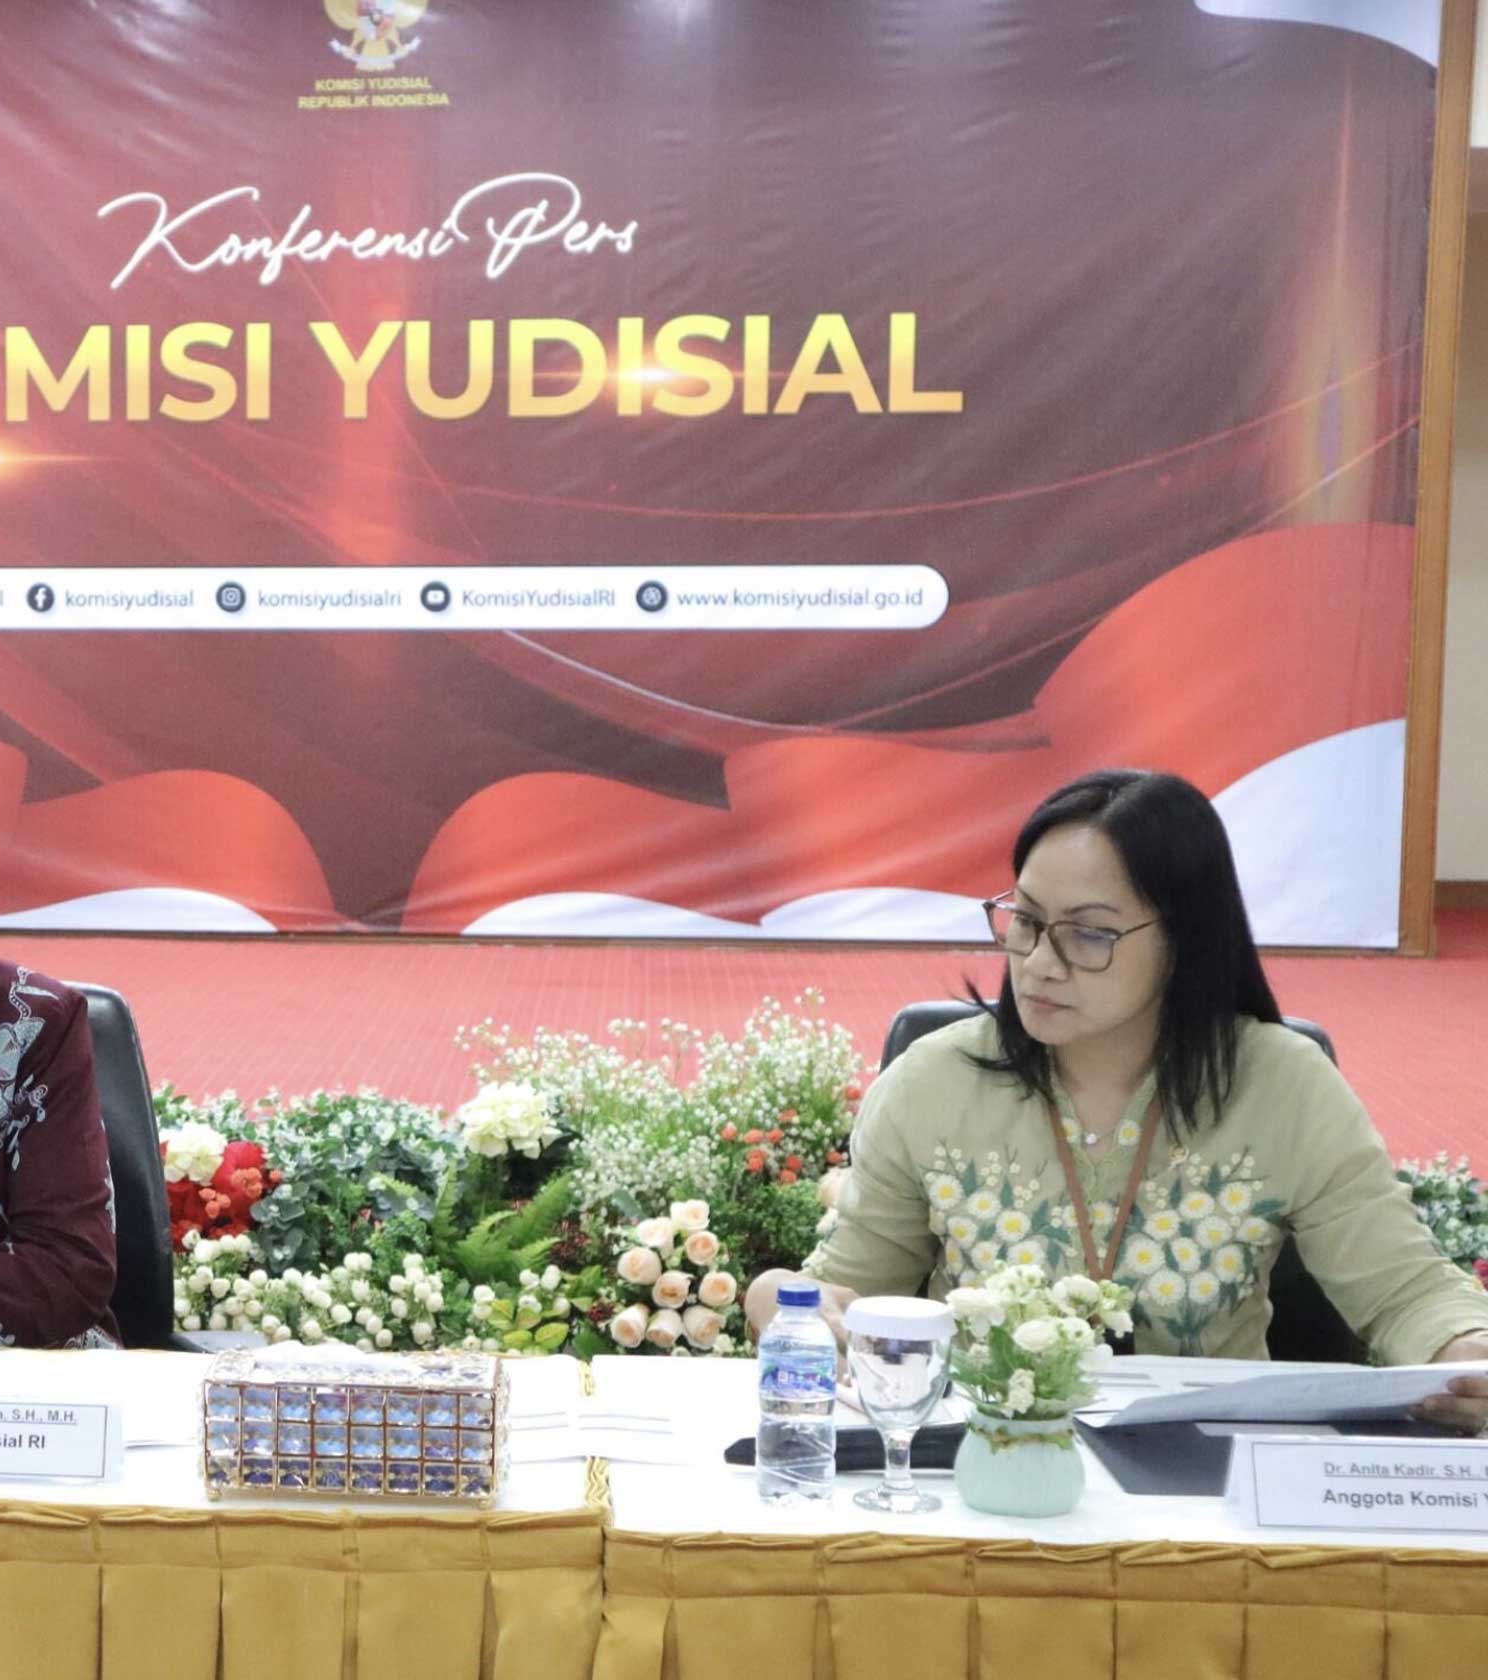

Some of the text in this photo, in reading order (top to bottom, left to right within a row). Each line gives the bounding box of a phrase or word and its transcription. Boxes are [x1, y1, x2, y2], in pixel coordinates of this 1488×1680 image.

[315, 76, 431, 91] KOMISI YUDISIAL
[298, 93, 449, 109] REPUBLIK INDONESIA
[99, 172, 638, 290] Konferensi Pers
[309, 312, 963, 419] YUDISIAL
[65, 587, 194, 612] komisiyudisial
[258, 587, 402, 612] komisiyudisialri
[462, 587, 616, 608] KomisiYudisialRI
[677, 586, 924, 612] www.komisiyudisial.go.id
[47, 1411, 77, 1423] M.H.
[28, 1435, 46, 1449] RI
[1324, 1462, 1344, 1475] Dr.
[1350, 1463, 1389, 1476] Anita
[1323, 1488, 1405, 1508] Anggota
[1410, 1490, 1478, 1508] Komisi
